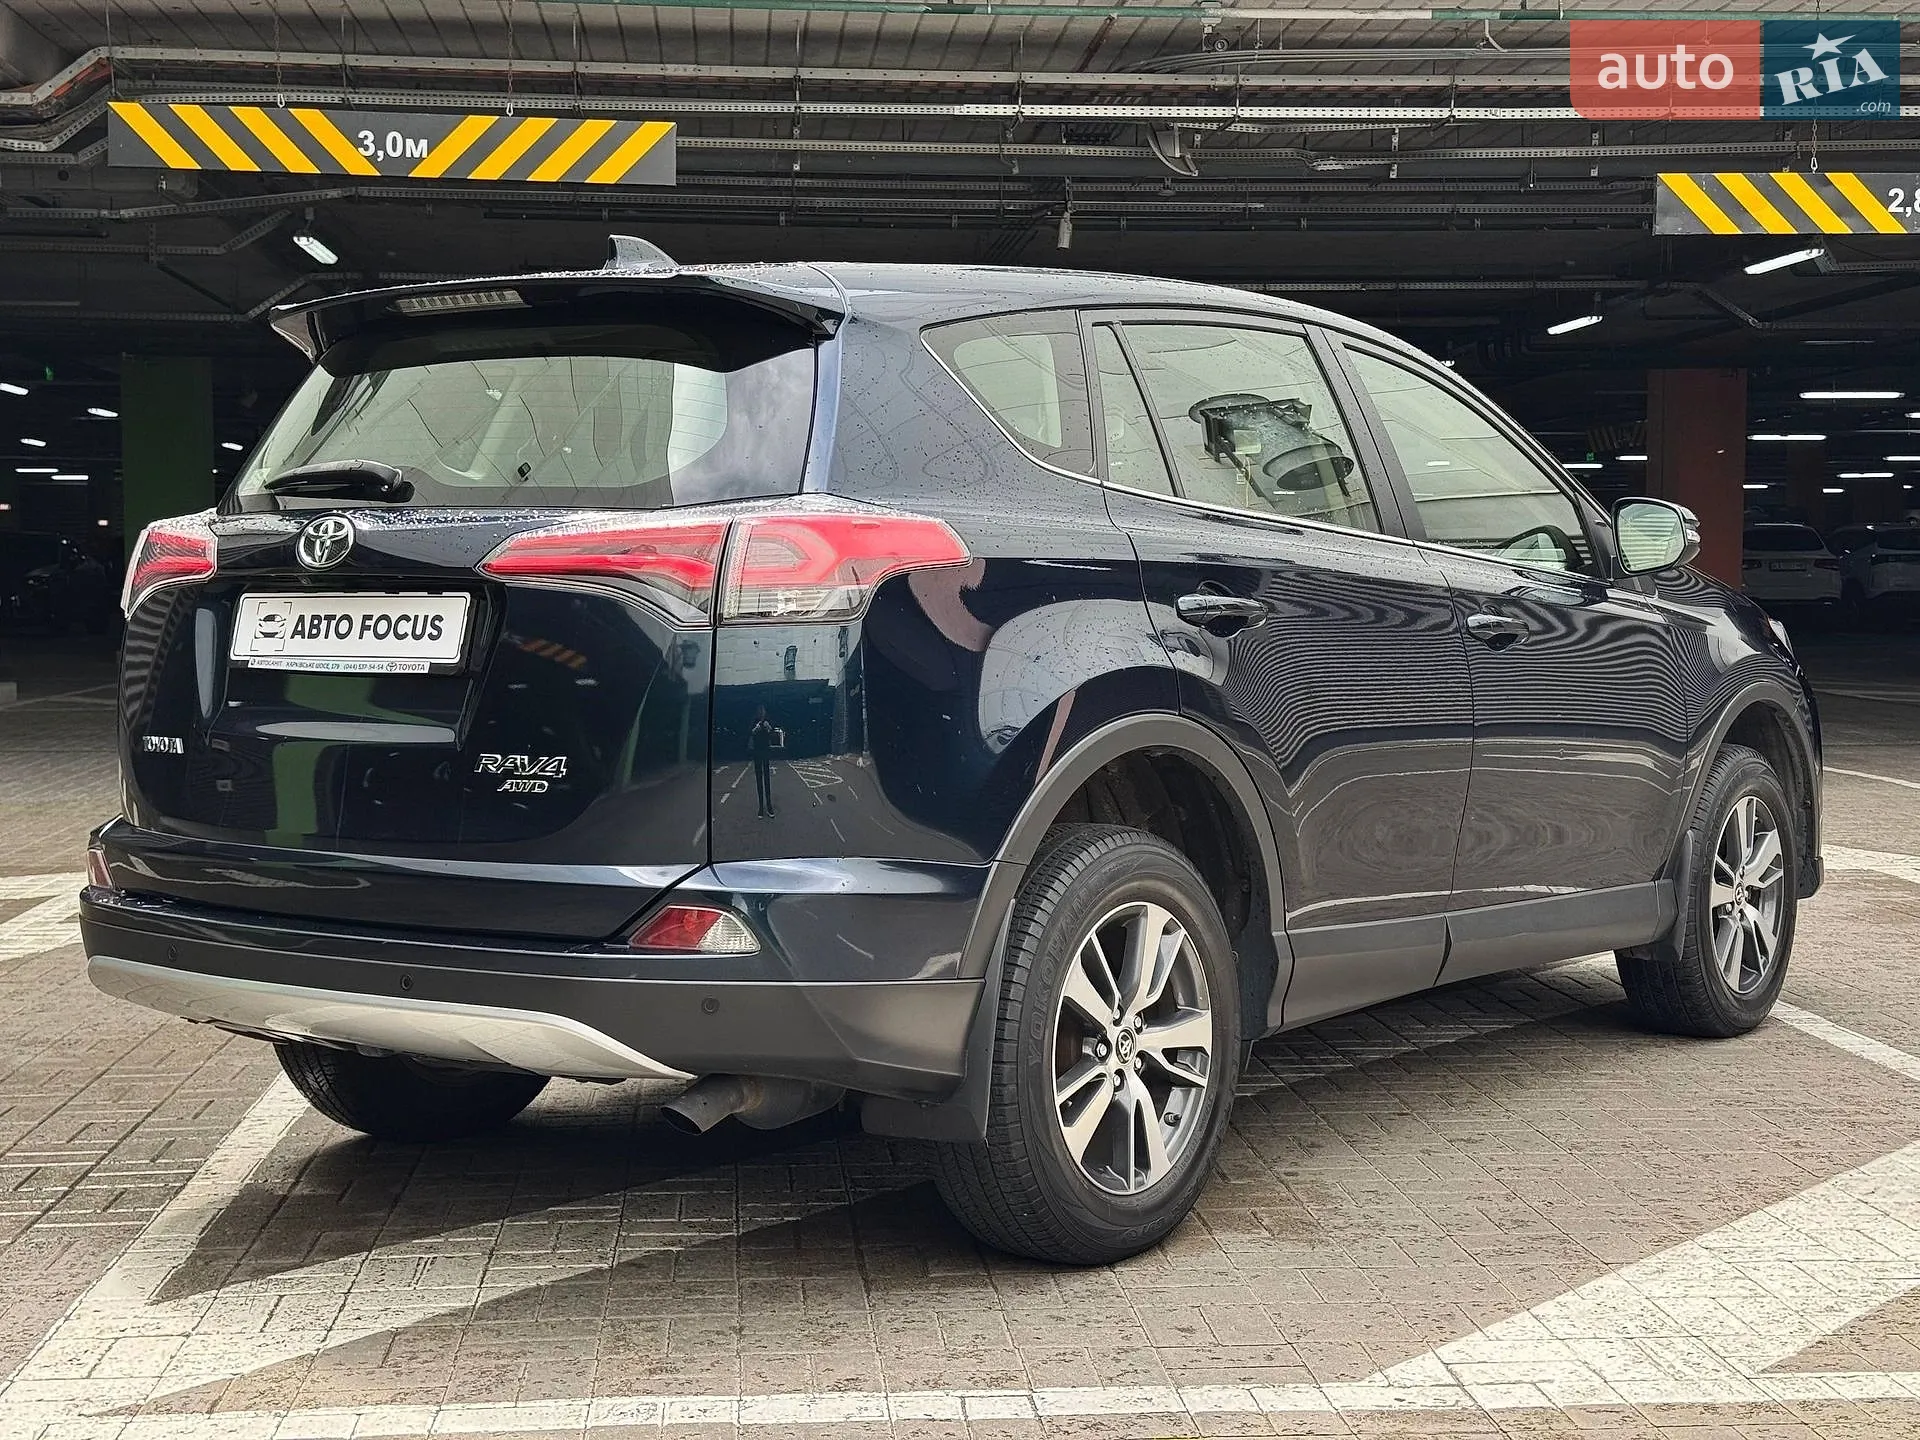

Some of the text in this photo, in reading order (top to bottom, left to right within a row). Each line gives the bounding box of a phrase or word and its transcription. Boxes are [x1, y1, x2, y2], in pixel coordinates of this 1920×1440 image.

[358, 614, 444, 641] FOCUS
[398, 663, 425, 672] TOYOTA
[474, 752, 568, 779] RAV4
[496, 779, 549, 793] AWD
